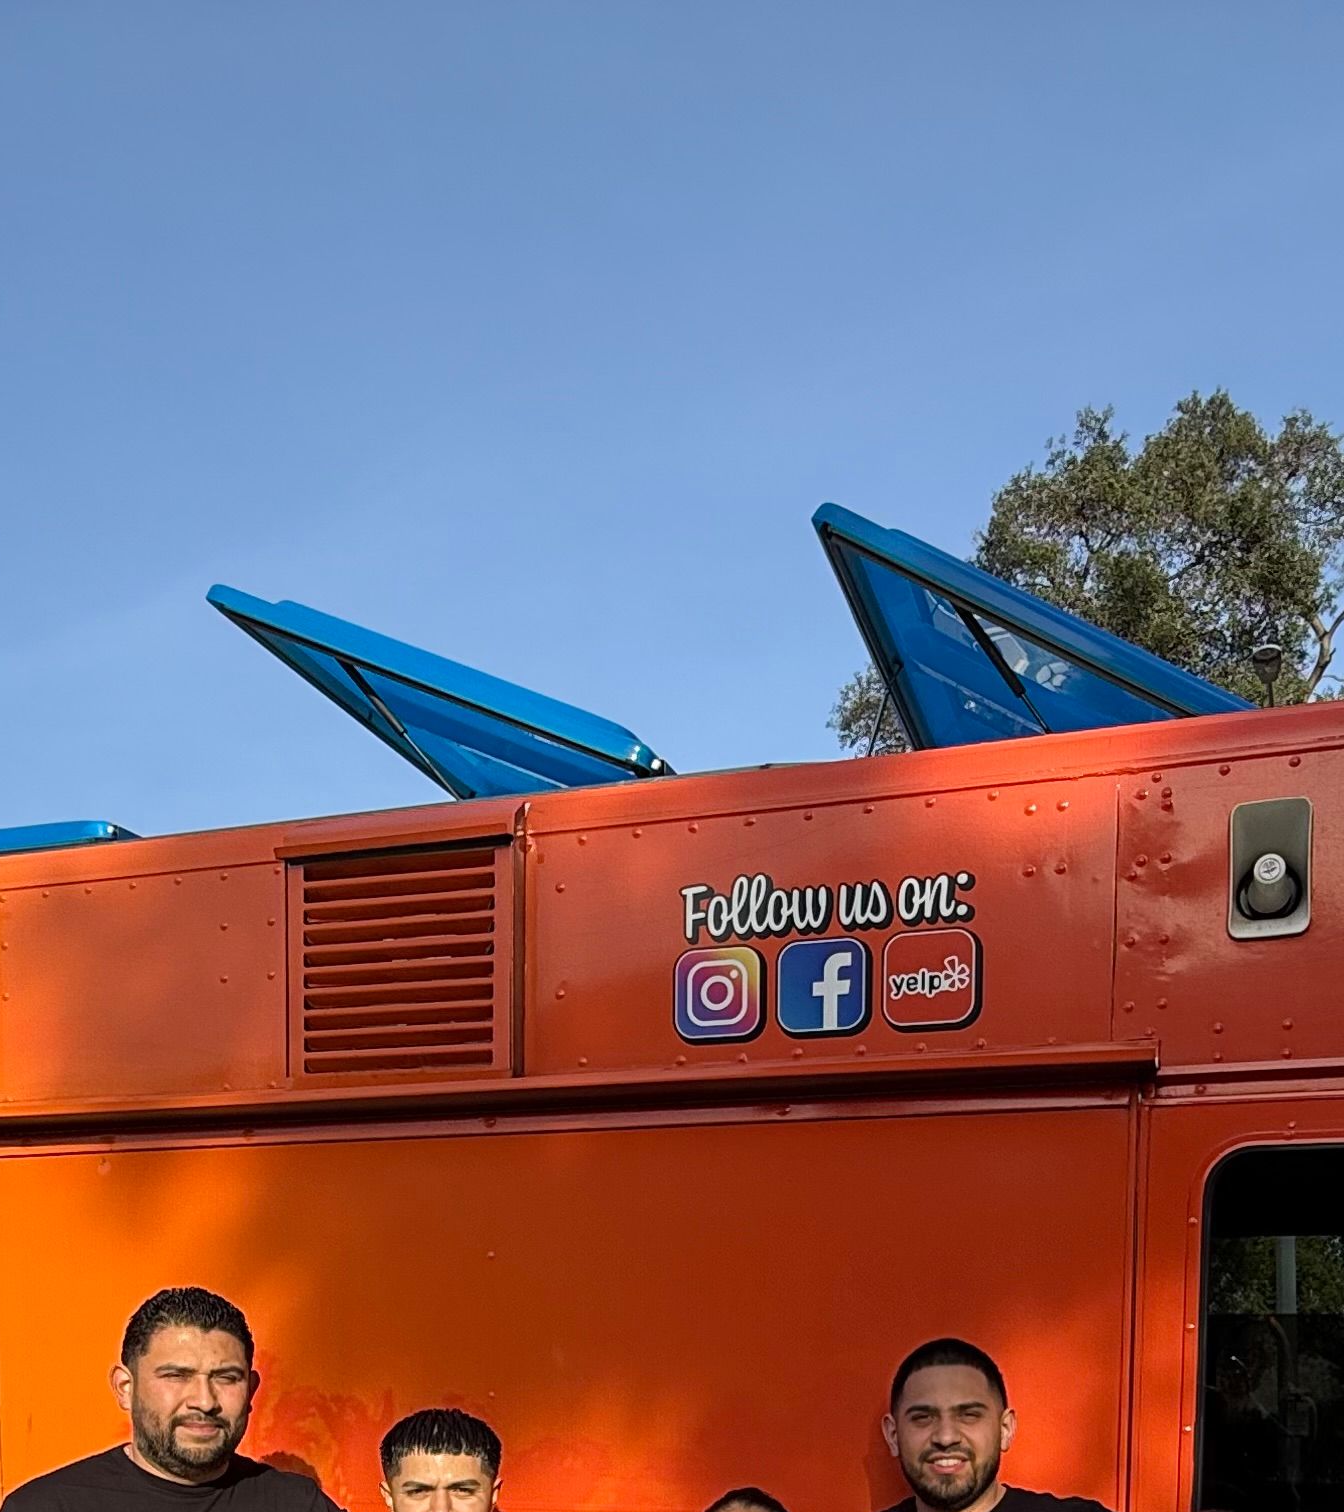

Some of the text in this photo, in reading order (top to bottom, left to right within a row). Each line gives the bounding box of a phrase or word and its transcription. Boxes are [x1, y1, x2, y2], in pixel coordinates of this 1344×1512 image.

[680, 871, 971, 941] Follow us on:
[890, 967, 944, 1000] yelp
